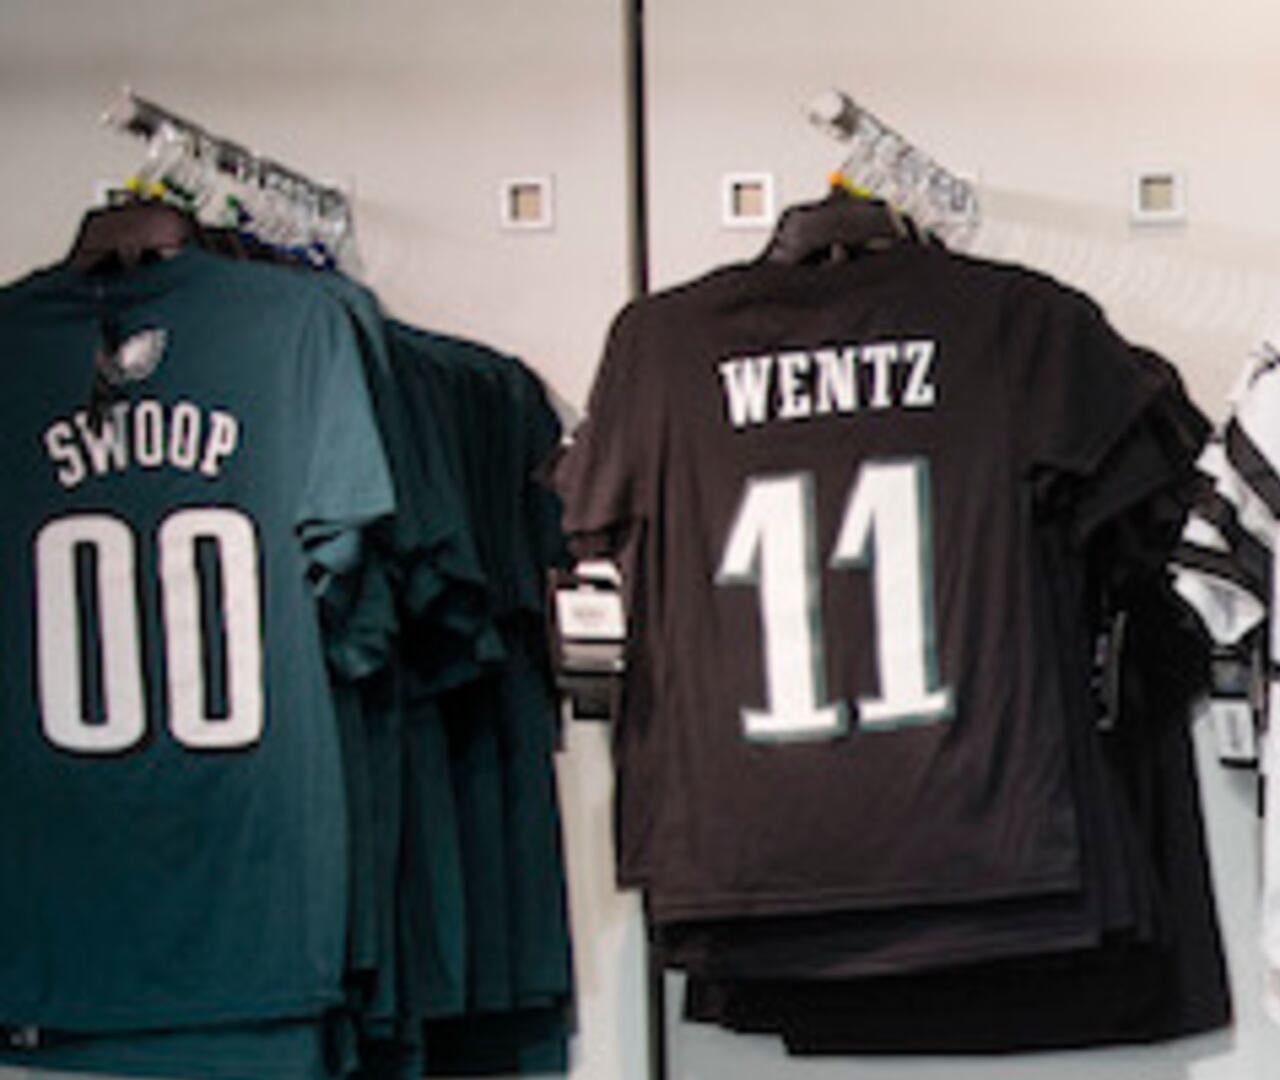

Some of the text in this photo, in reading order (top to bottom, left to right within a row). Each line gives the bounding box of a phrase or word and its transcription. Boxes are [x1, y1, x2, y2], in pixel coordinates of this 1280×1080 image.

[45, 399, 239, 487] SWOOP
[719, 341, 936, 427] WENTZ
[35, 506, 267, 755] 00
[716, 462, 952, 744] 11
